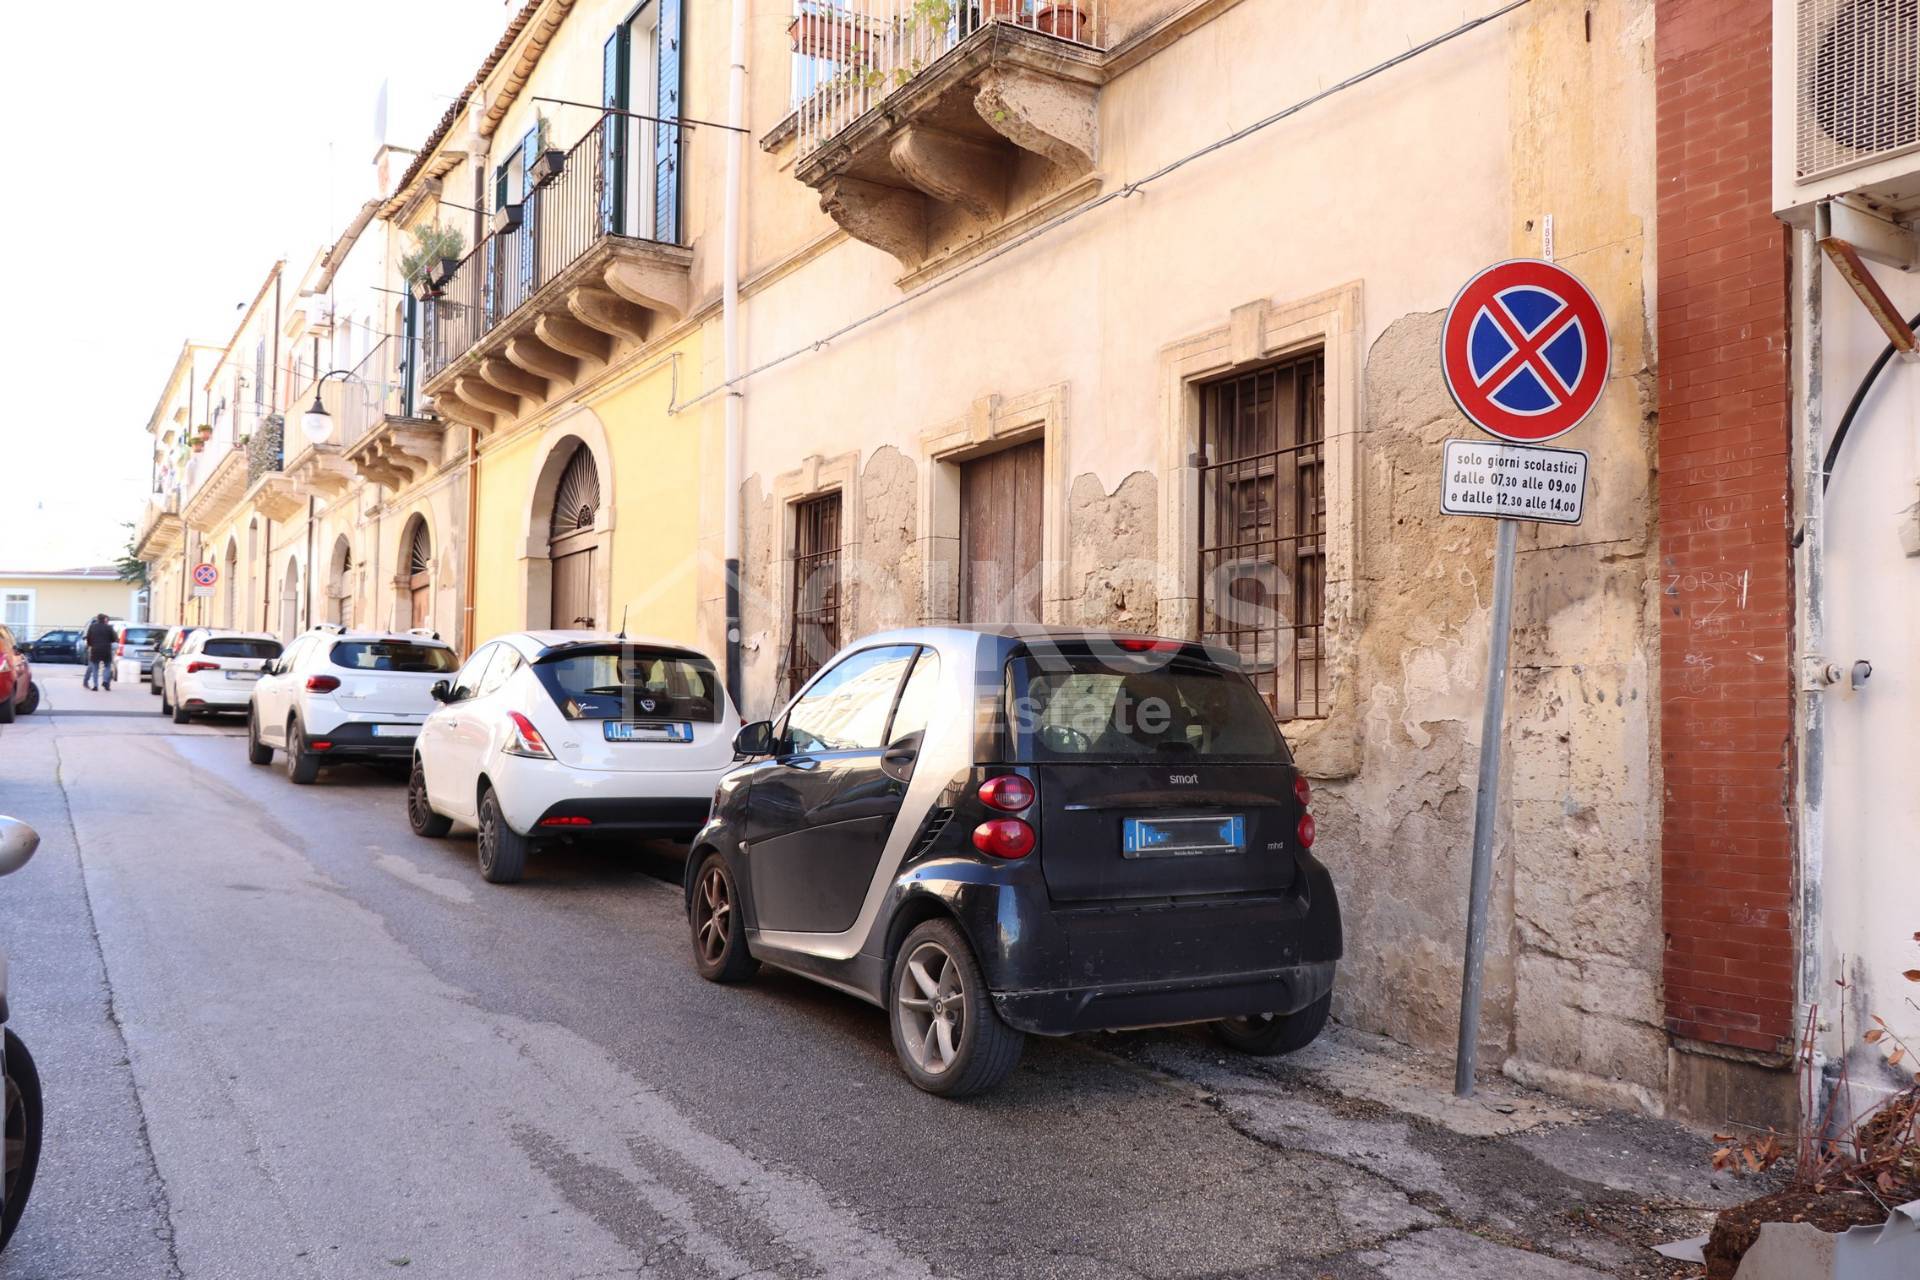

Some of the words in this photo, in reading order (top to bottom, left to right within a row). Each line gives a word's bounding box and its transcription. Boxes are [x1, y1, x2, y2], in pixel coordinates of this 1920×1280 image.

[1457, 453, 1481, 465] solo
[1487, 454, 1520, 469] giorni
[1524, 459, 1577, 474] scolastici
[1453, 471, 1485, 485] dalle
[1490, 473, 1517, 488] 07.30
[1522, 477, 1543, 490] alle
[1548, 479, 1577, 494] 09.00
[1451, 492, 1458, 502] e
[1462, 490, 1493, 504] dalle
[1497, 492, 1522, 507] 12.30
[1525, 497, 1547, 510] alle
[1550, 498, 1576, 513] 14.00
[1169, 774, 1199, 785] smart
[1267, 842, 1284, 850] mhd
